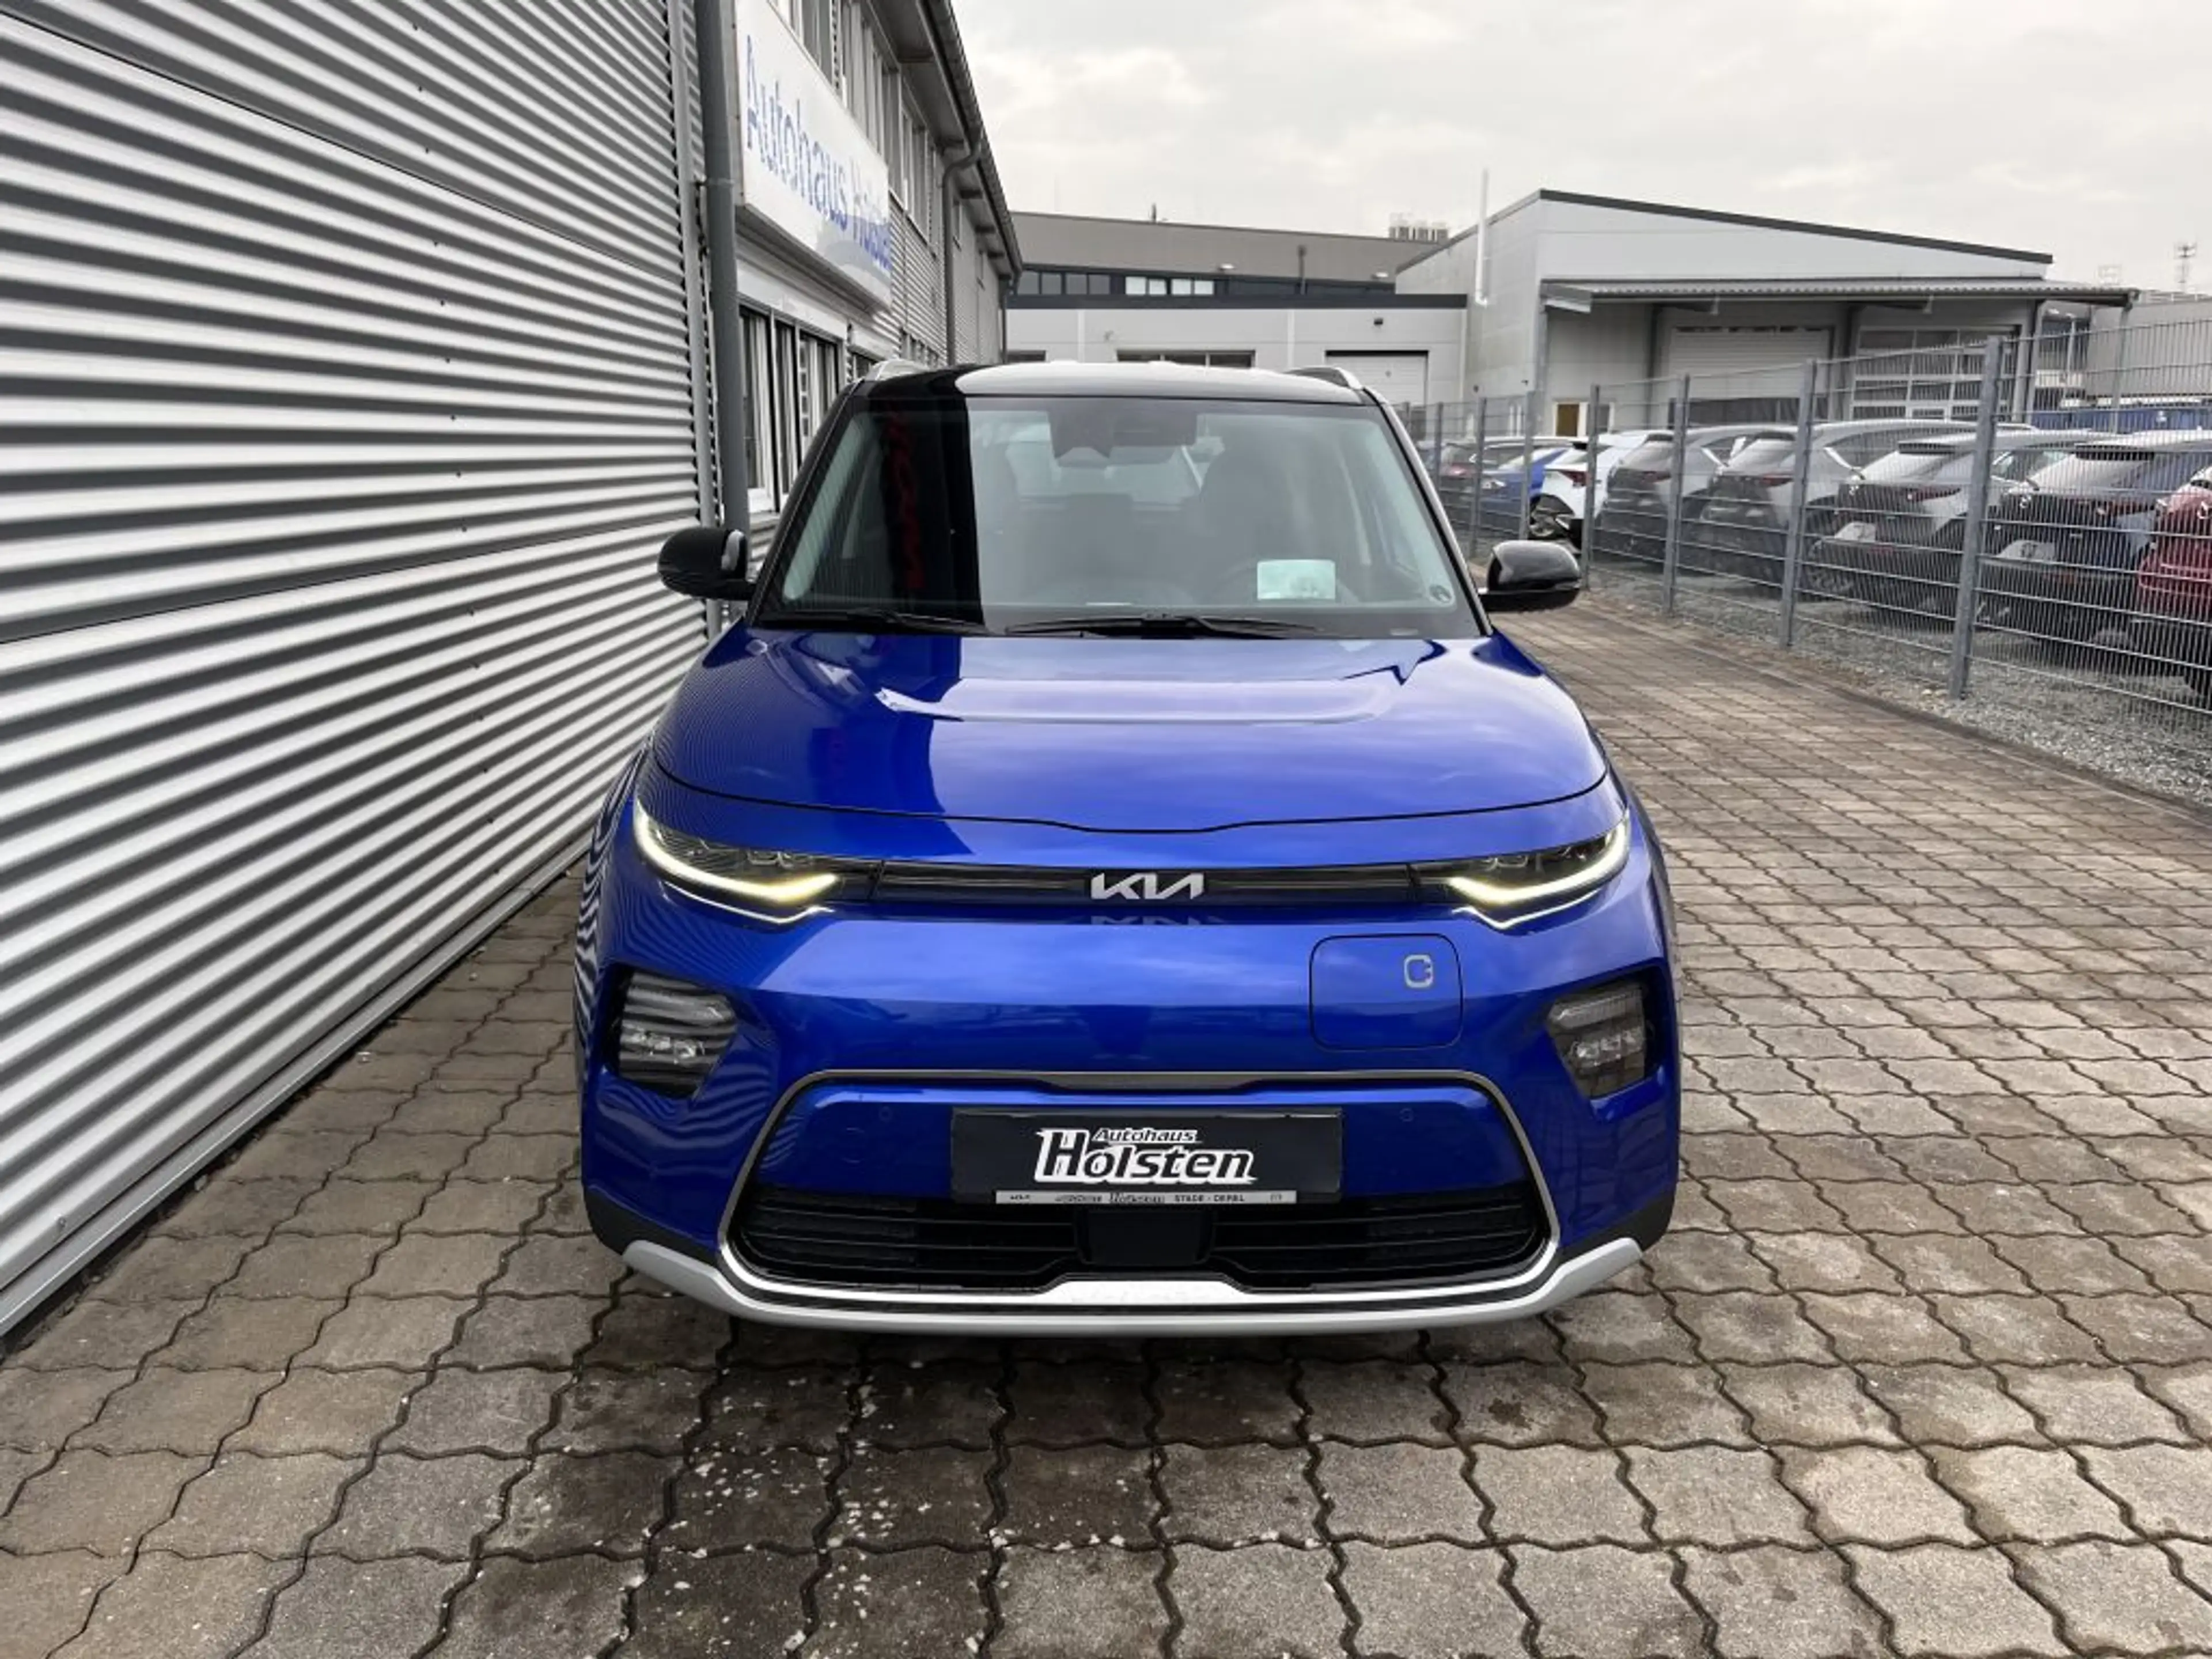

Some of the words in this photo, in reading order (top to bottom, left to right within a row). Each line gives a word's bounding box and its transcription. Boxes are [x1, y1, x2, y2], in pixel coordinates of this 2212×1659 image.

[747, 34, 848, 231] Autohaus
[1091, 873, 1204, 899] KIA
[1092, 1127, 1201, 1143] Autohaus
[1035, 1128, 1257, 1184] Holsten
